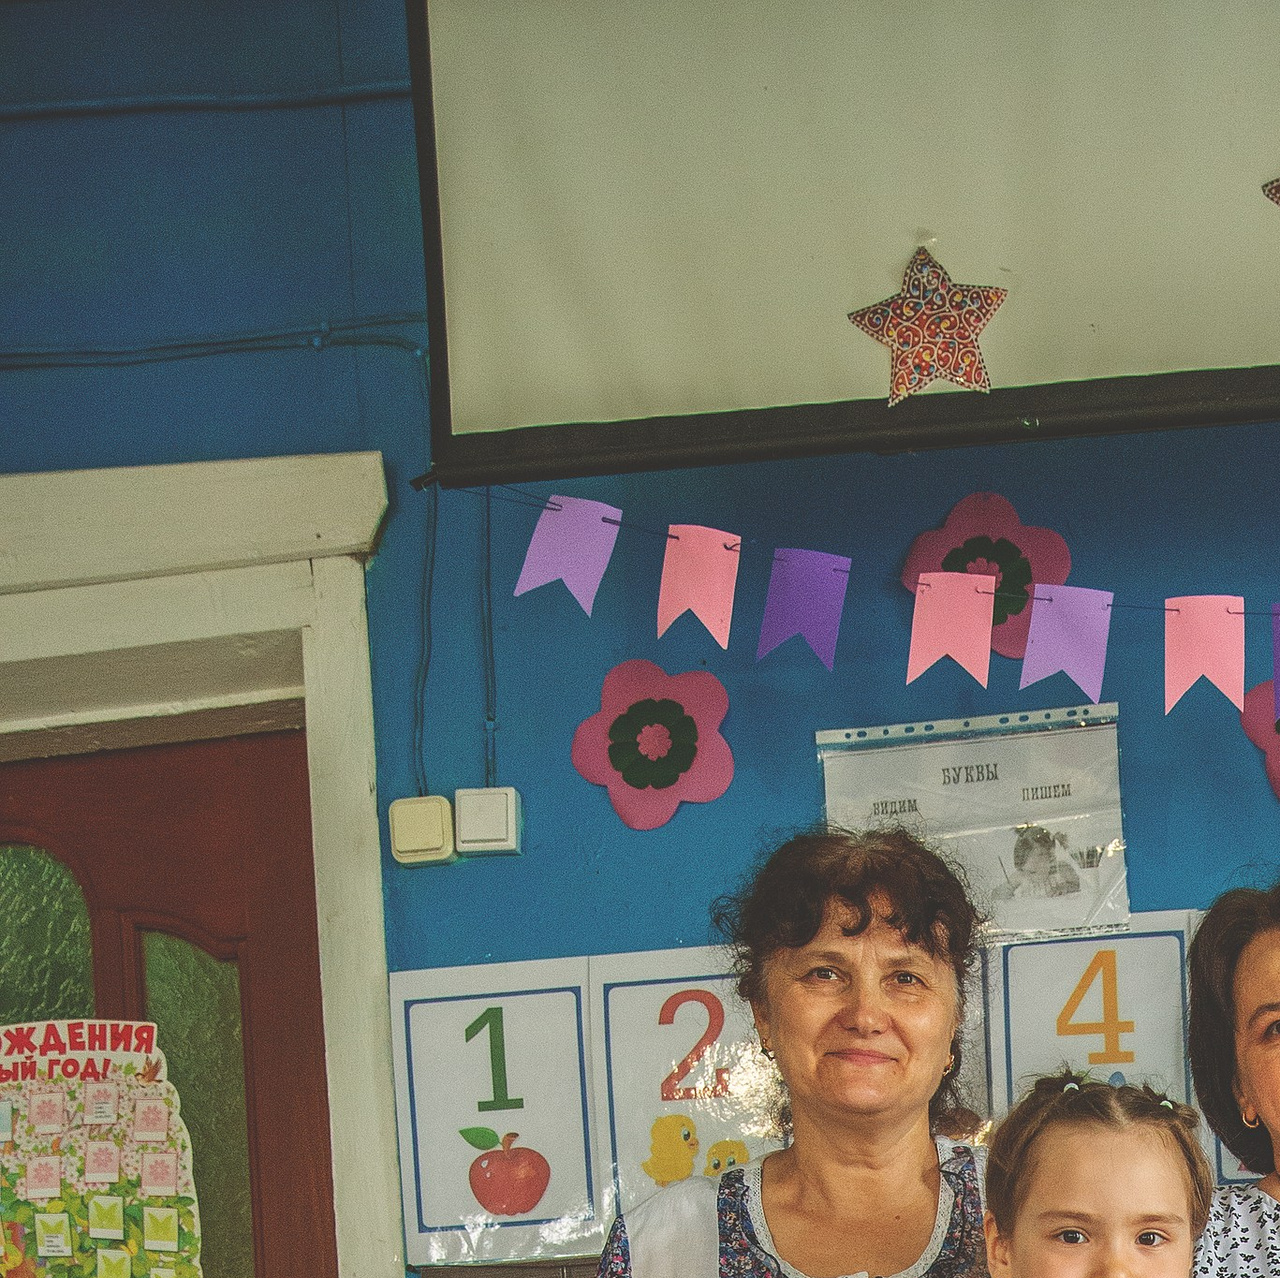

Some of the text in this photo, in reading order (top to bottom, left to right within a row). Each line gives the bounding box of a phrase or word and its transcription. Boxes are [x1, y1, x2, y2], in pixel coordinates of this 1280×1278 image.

[941, 763, 999, 786] БУКВЫ
[873, 798, 918, 816] ВИДИМ
[1022, 784, 1072, 802] ПИШЕМ
[1056, 949, 1135, 1065] 4
[0, 1021, 156, 1057] ЖДЕНИЯ
[658, 989, 731, 1102] 2
[48, 1058, 112, 1081] ГОД!
[464, 1006, 524, 1112] 1
